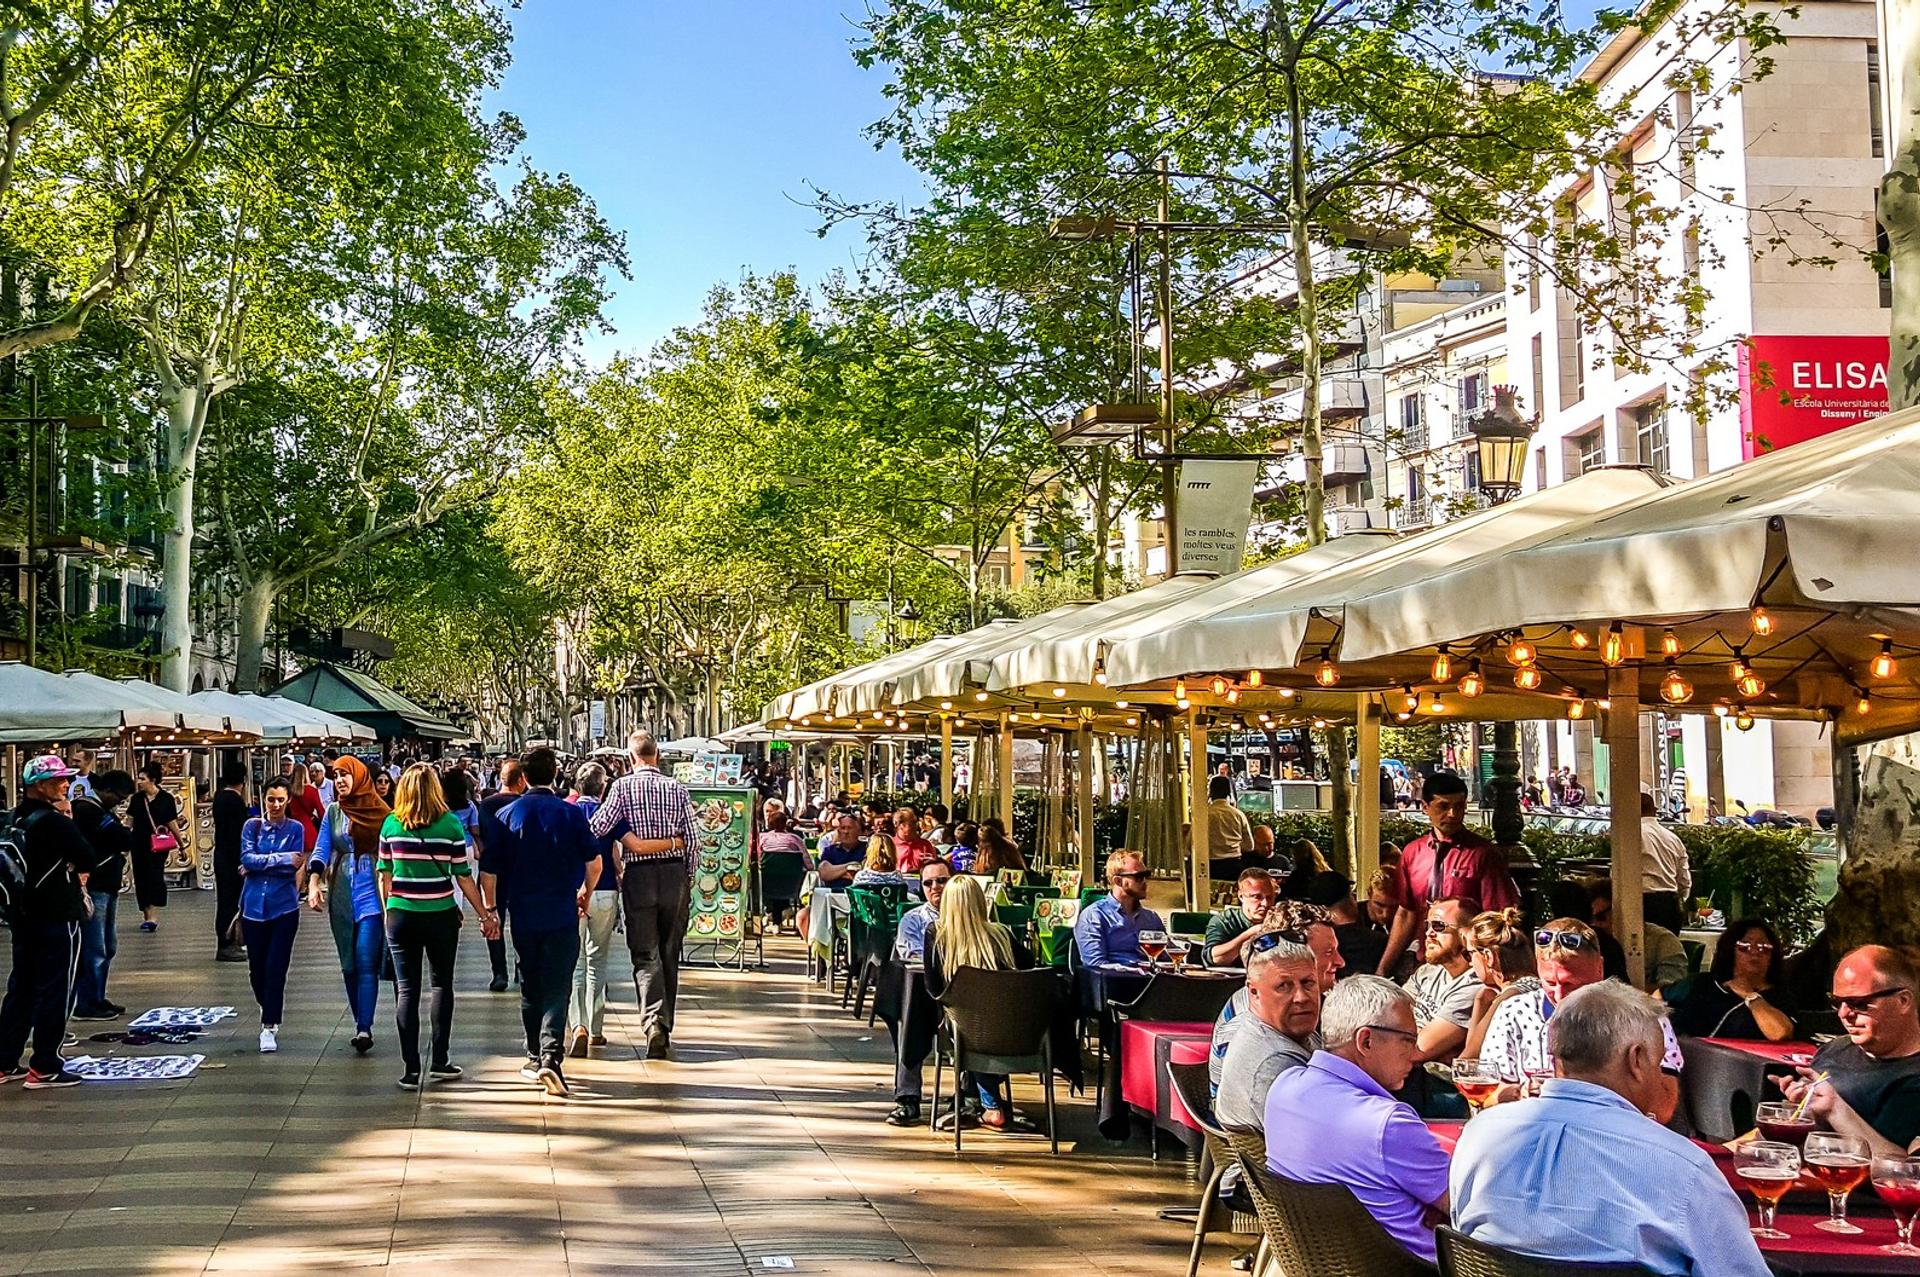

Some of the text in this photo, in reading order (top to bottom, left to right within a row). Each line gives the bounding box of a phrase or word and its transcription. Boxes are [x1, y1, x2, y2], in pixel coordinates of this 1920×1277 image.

[1792, 362, 1888, 389] ELISA
[1794, 399, 1822, 407] Escola
[1824, 399, 1878, 408] Universitària
[1821, 409, 1856, 419] Disseny
[1184, 528, 1196, 536] les
[1183, 540, 1235, 550] moltes veus
[1182, 552, 1218, 561] diverses
